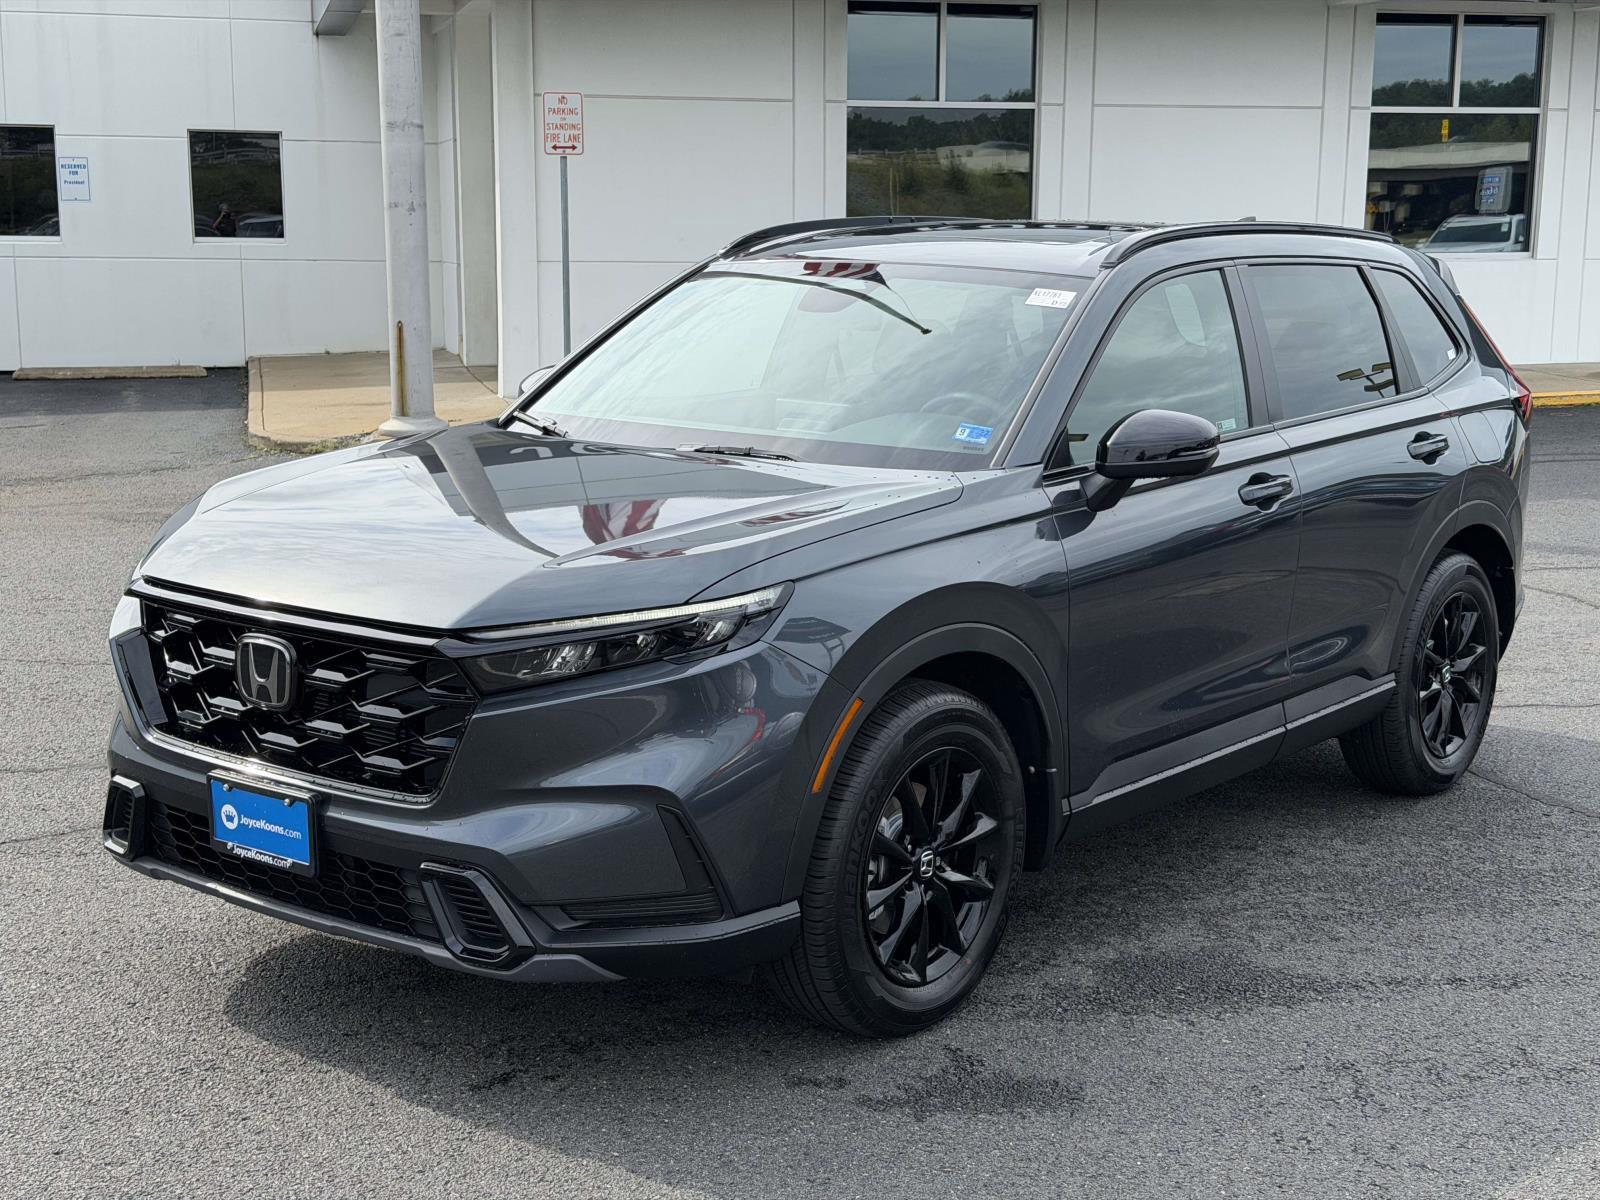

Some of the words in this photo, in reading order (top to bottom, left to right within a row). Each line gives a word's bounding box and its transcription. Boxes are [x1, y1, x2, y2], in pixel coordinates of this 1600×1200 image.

[557, 95, 568, 105] NO
[547, 107, 579, 116] PARKING
[546, 123, 581, 131] STANDING
[545, 133, 561, 143] FIRE
[563, 134, 582, 143] LANE
[240, 814, 302, 840] JoyceKoons.com
[233, 845, 290, 869] JoyceKoons.com
